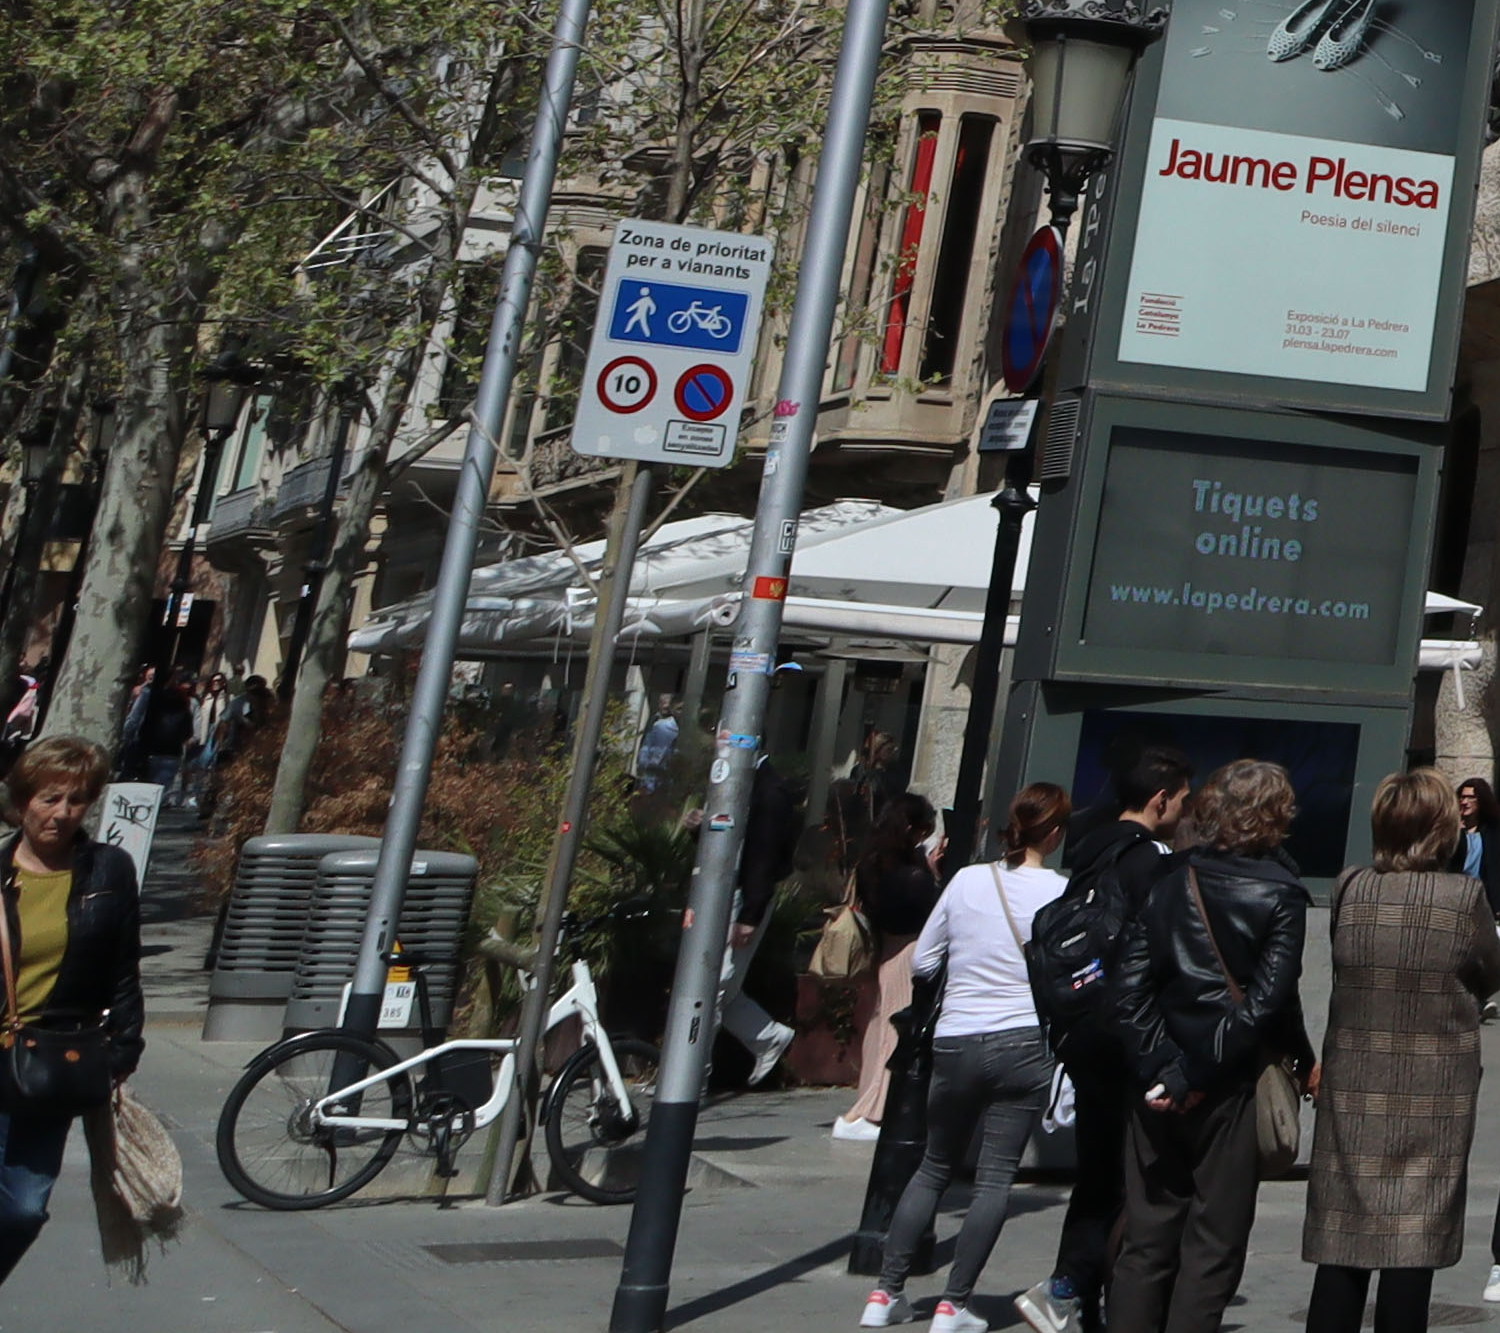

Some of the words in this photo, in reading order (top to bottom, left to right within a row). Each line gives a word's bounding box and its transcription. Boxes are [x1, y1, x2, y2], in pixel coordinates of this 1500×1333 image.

[1159, 138, 1298, 192] Jaume
[1305, 156, 1440, 209] Plensa
[1300, 209, 1347, 229] Poesia
[1351, 215, 1373, 231] del
[1376, 220, 1421, 238] silenci
[618, 229, 665, 249] Zona
[669, 236, 692, 252] de
[696, 242, 766, 263] prioritat
[626, 253, 658, 269] per
[661, 258, 672, 269] a
[677, 258, 751, 280] vianants
[1284, 322, 1313, 336] 31.03
[1321, 326, 1351, 340] 23.07
[1286, 308, 1340, 326] Exposició
[1341, 319, 1349, 327] a
[1351, 316, 1366, 328] La
[1367, 318, 1410, 333] Pedrera
[1282, 336, 1399, 358] plensa.lapedrera.com
[614, 374, 641, 395] 10
[1192, 478, 1319, 523] Tiquets
[1195, 525, 1303, 562] online
[1110, 582, 1371, 620] www.lapedrera.com
